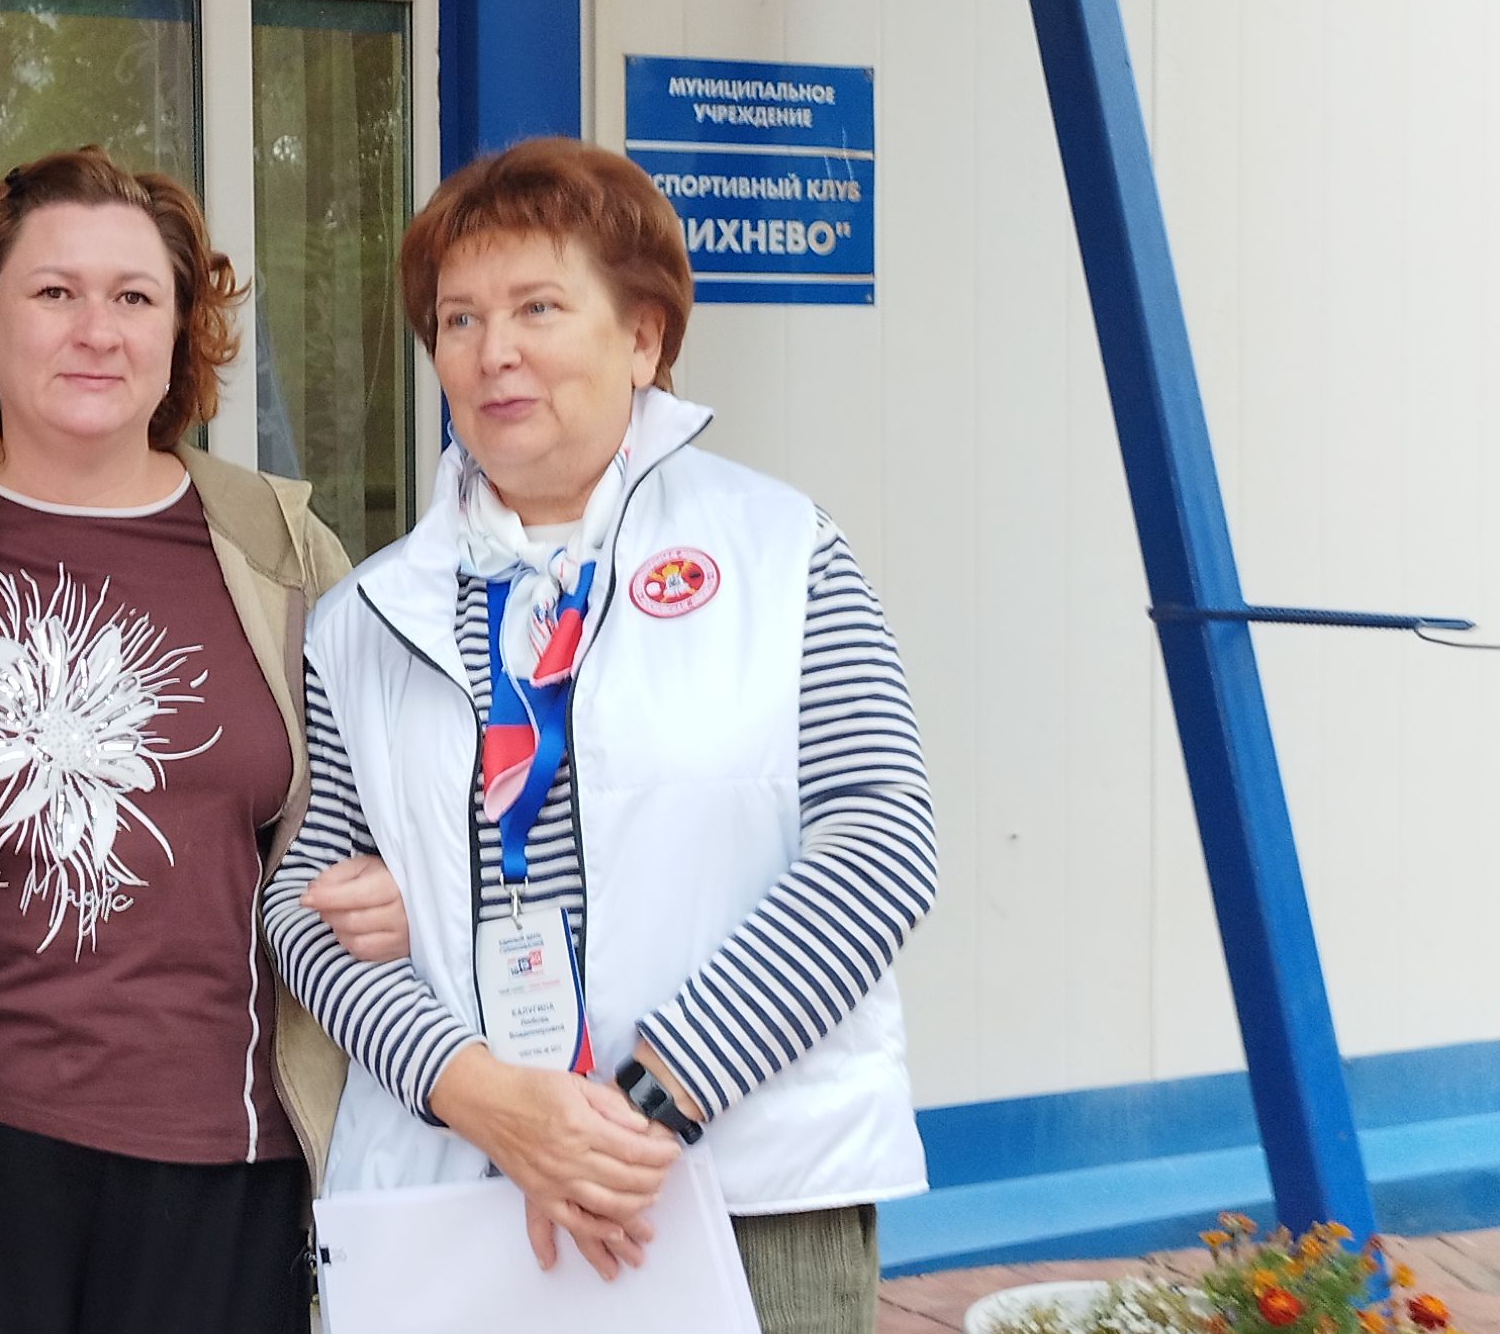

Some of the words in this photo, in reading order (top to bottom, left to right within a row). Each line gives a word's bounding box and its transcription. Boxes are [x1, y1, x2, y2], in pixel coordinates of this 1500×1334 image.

[668, 76, 836, 105] МУНИЦИПАЛЬНОЕ
[693, 102, 813, 128] УЧРЕЖДЕНИЕ
[806, 178, 862, 203] КЛУБ
[679, 217, 852, 256] ИХНЕВО"
